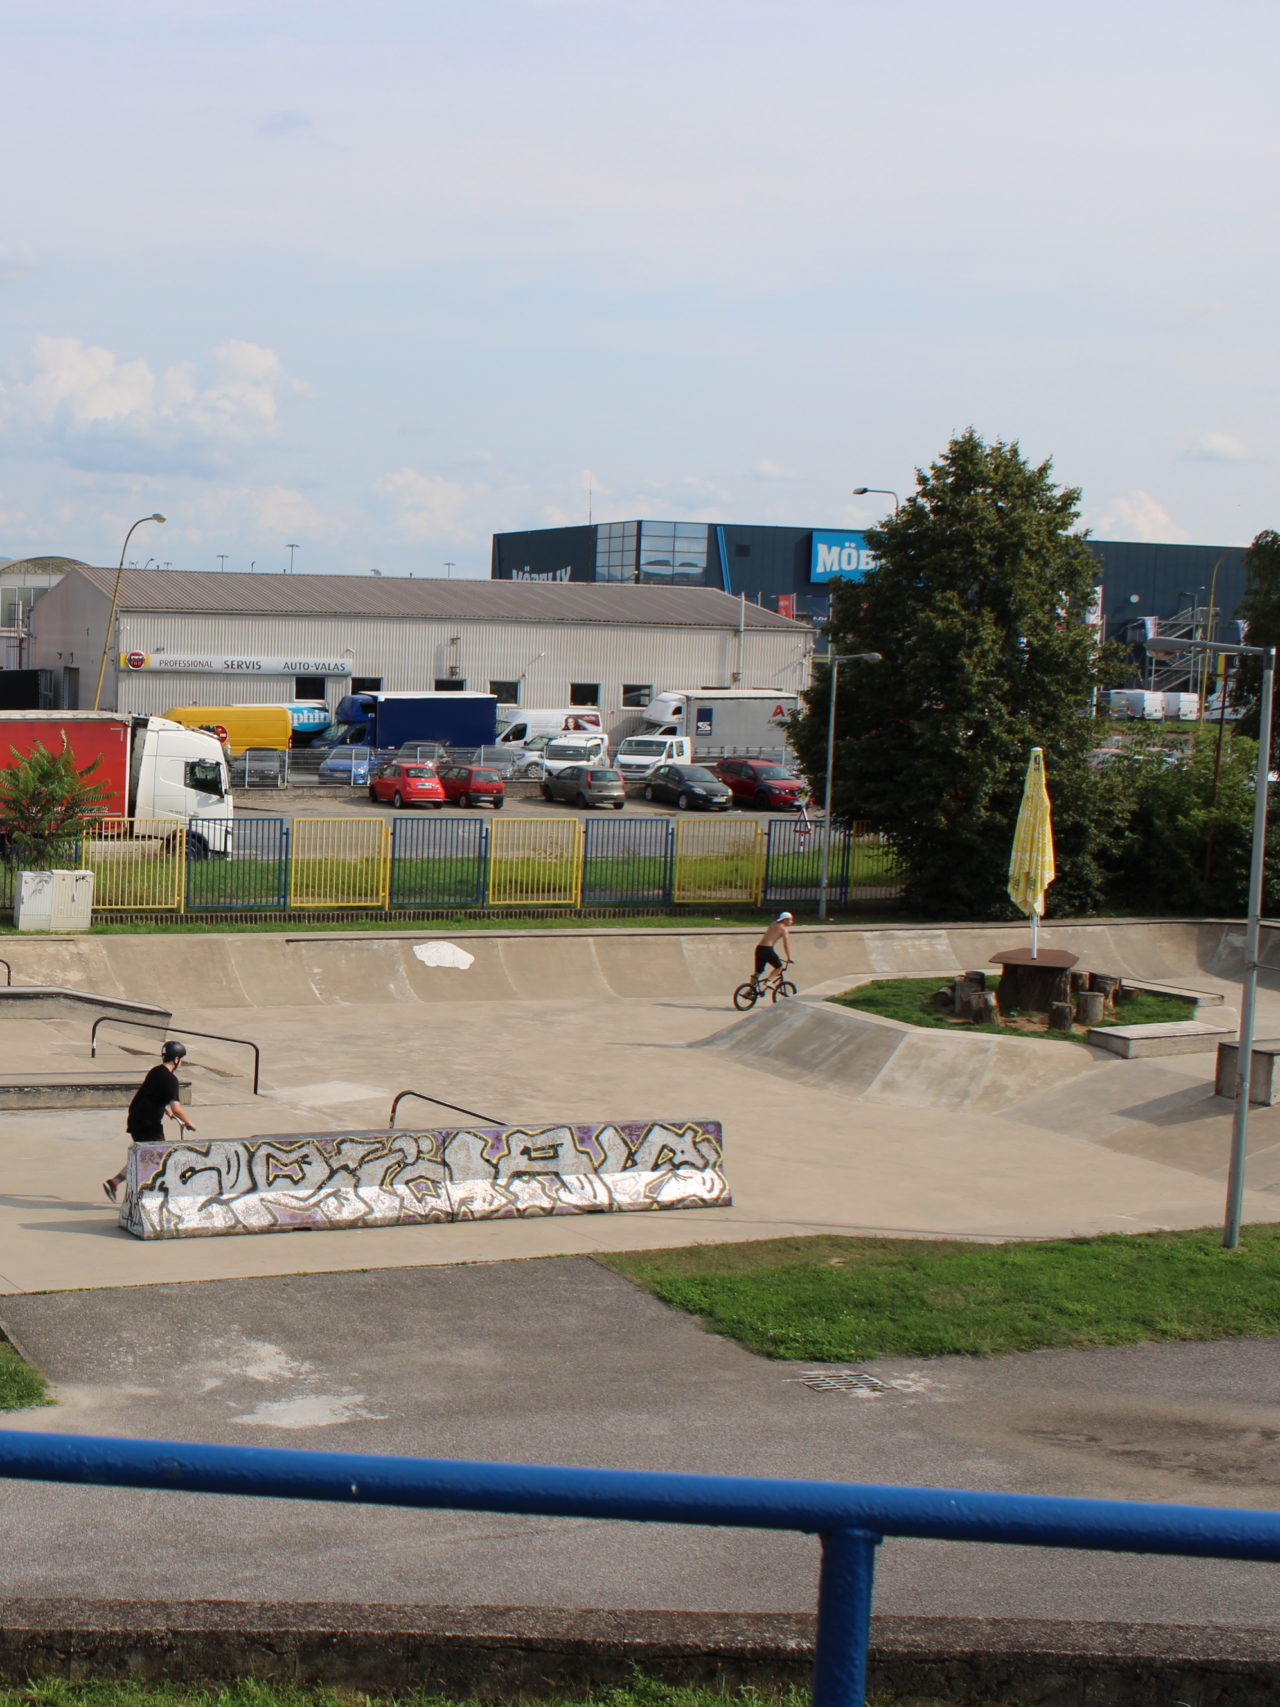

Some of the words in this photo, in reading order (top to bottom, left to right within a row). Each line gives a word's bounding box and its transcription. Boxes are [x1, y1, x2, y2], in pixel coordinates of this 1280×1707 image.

[159, 659, 213, 668] PROFESSIONAL
[224, 660, 262, 670] SERVIS
[283, 662, 345, 672] AUTO-VALAS
